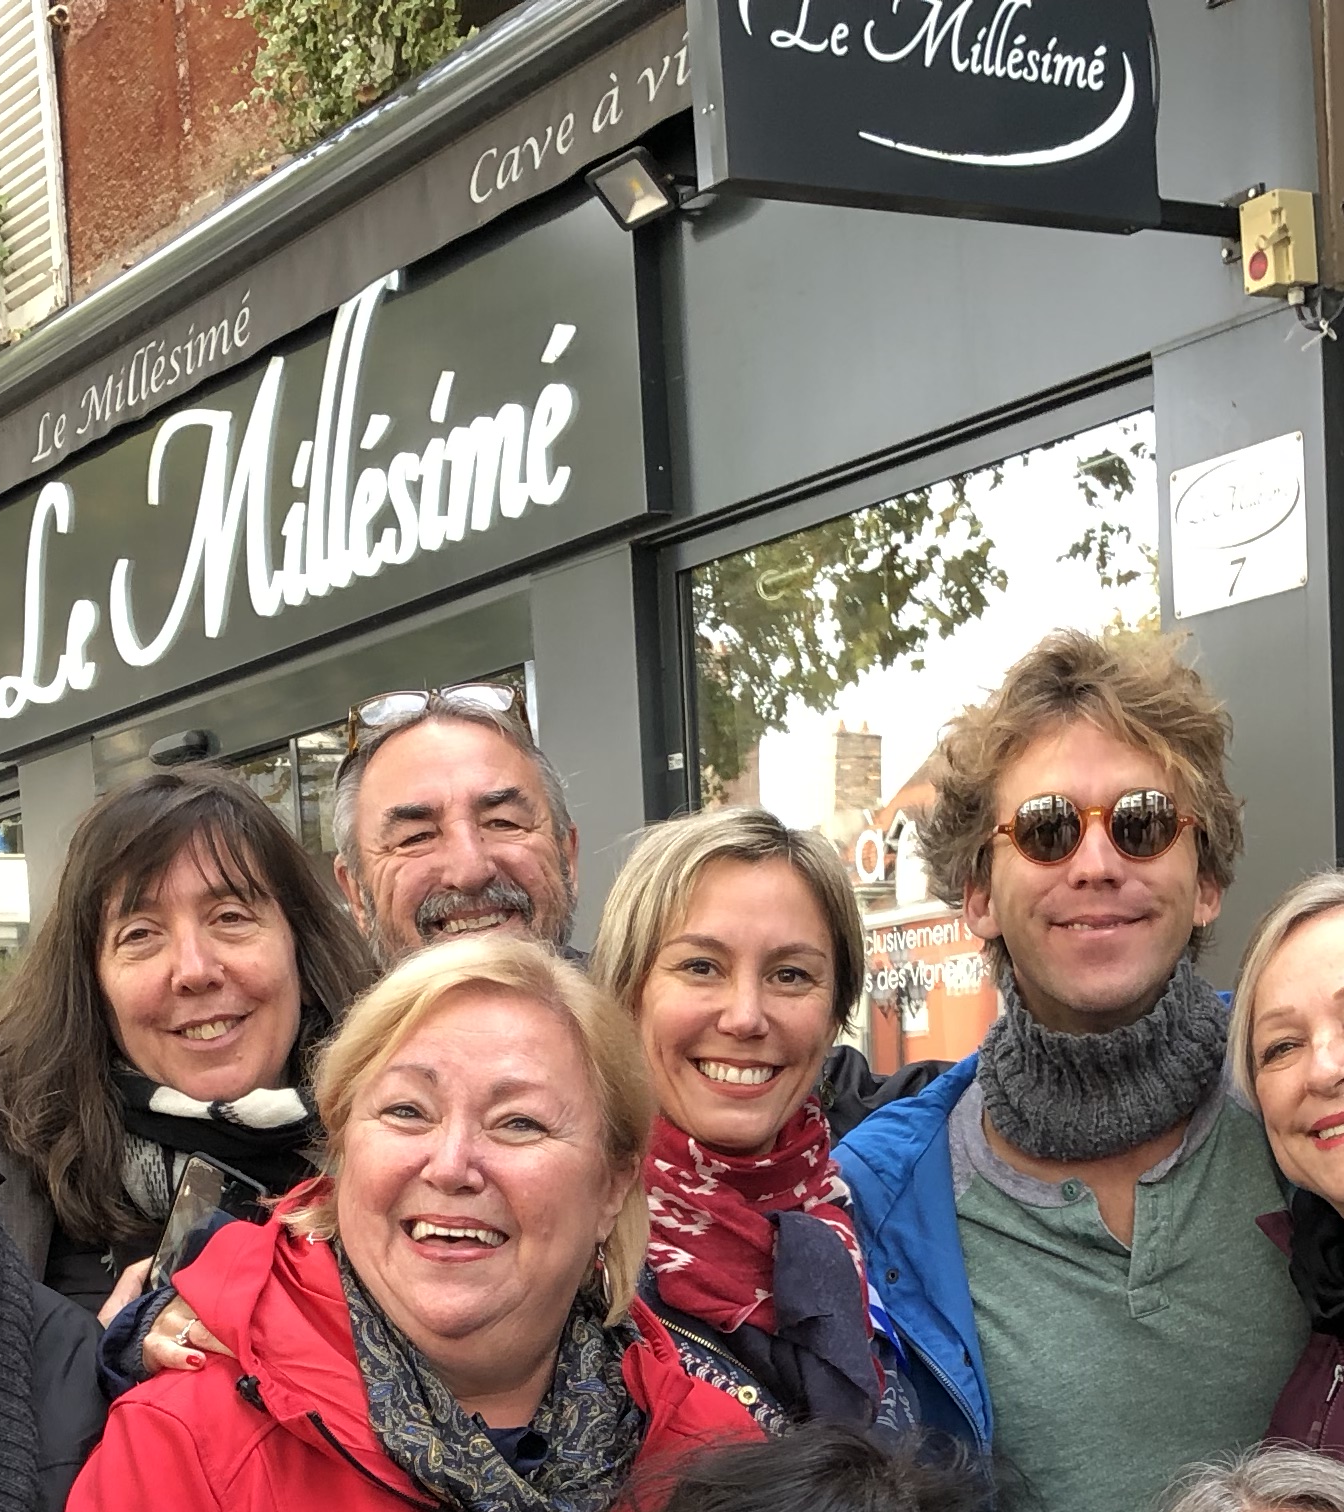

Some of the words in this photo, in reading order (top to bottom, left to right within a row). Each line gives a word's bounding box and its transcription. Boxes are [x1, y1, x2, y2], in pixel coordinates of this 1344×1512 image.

[770, 0, 849, 56] Le
[864, 0, 1107, 91] Millésimé
[469, 116, 575, 204] Cave
[592, 73, 623, 133] à
[637, 32, 692, 102] vi
[31, 412, 67, 463] Le
[76, 288, 251, 434] Millésimé
[110, 268, 578, 668] Millésimé
[1229, 556, 1247, 597] 7
[864, 918, 960, 956] clusivement
[876, 965, 907, 991] des
